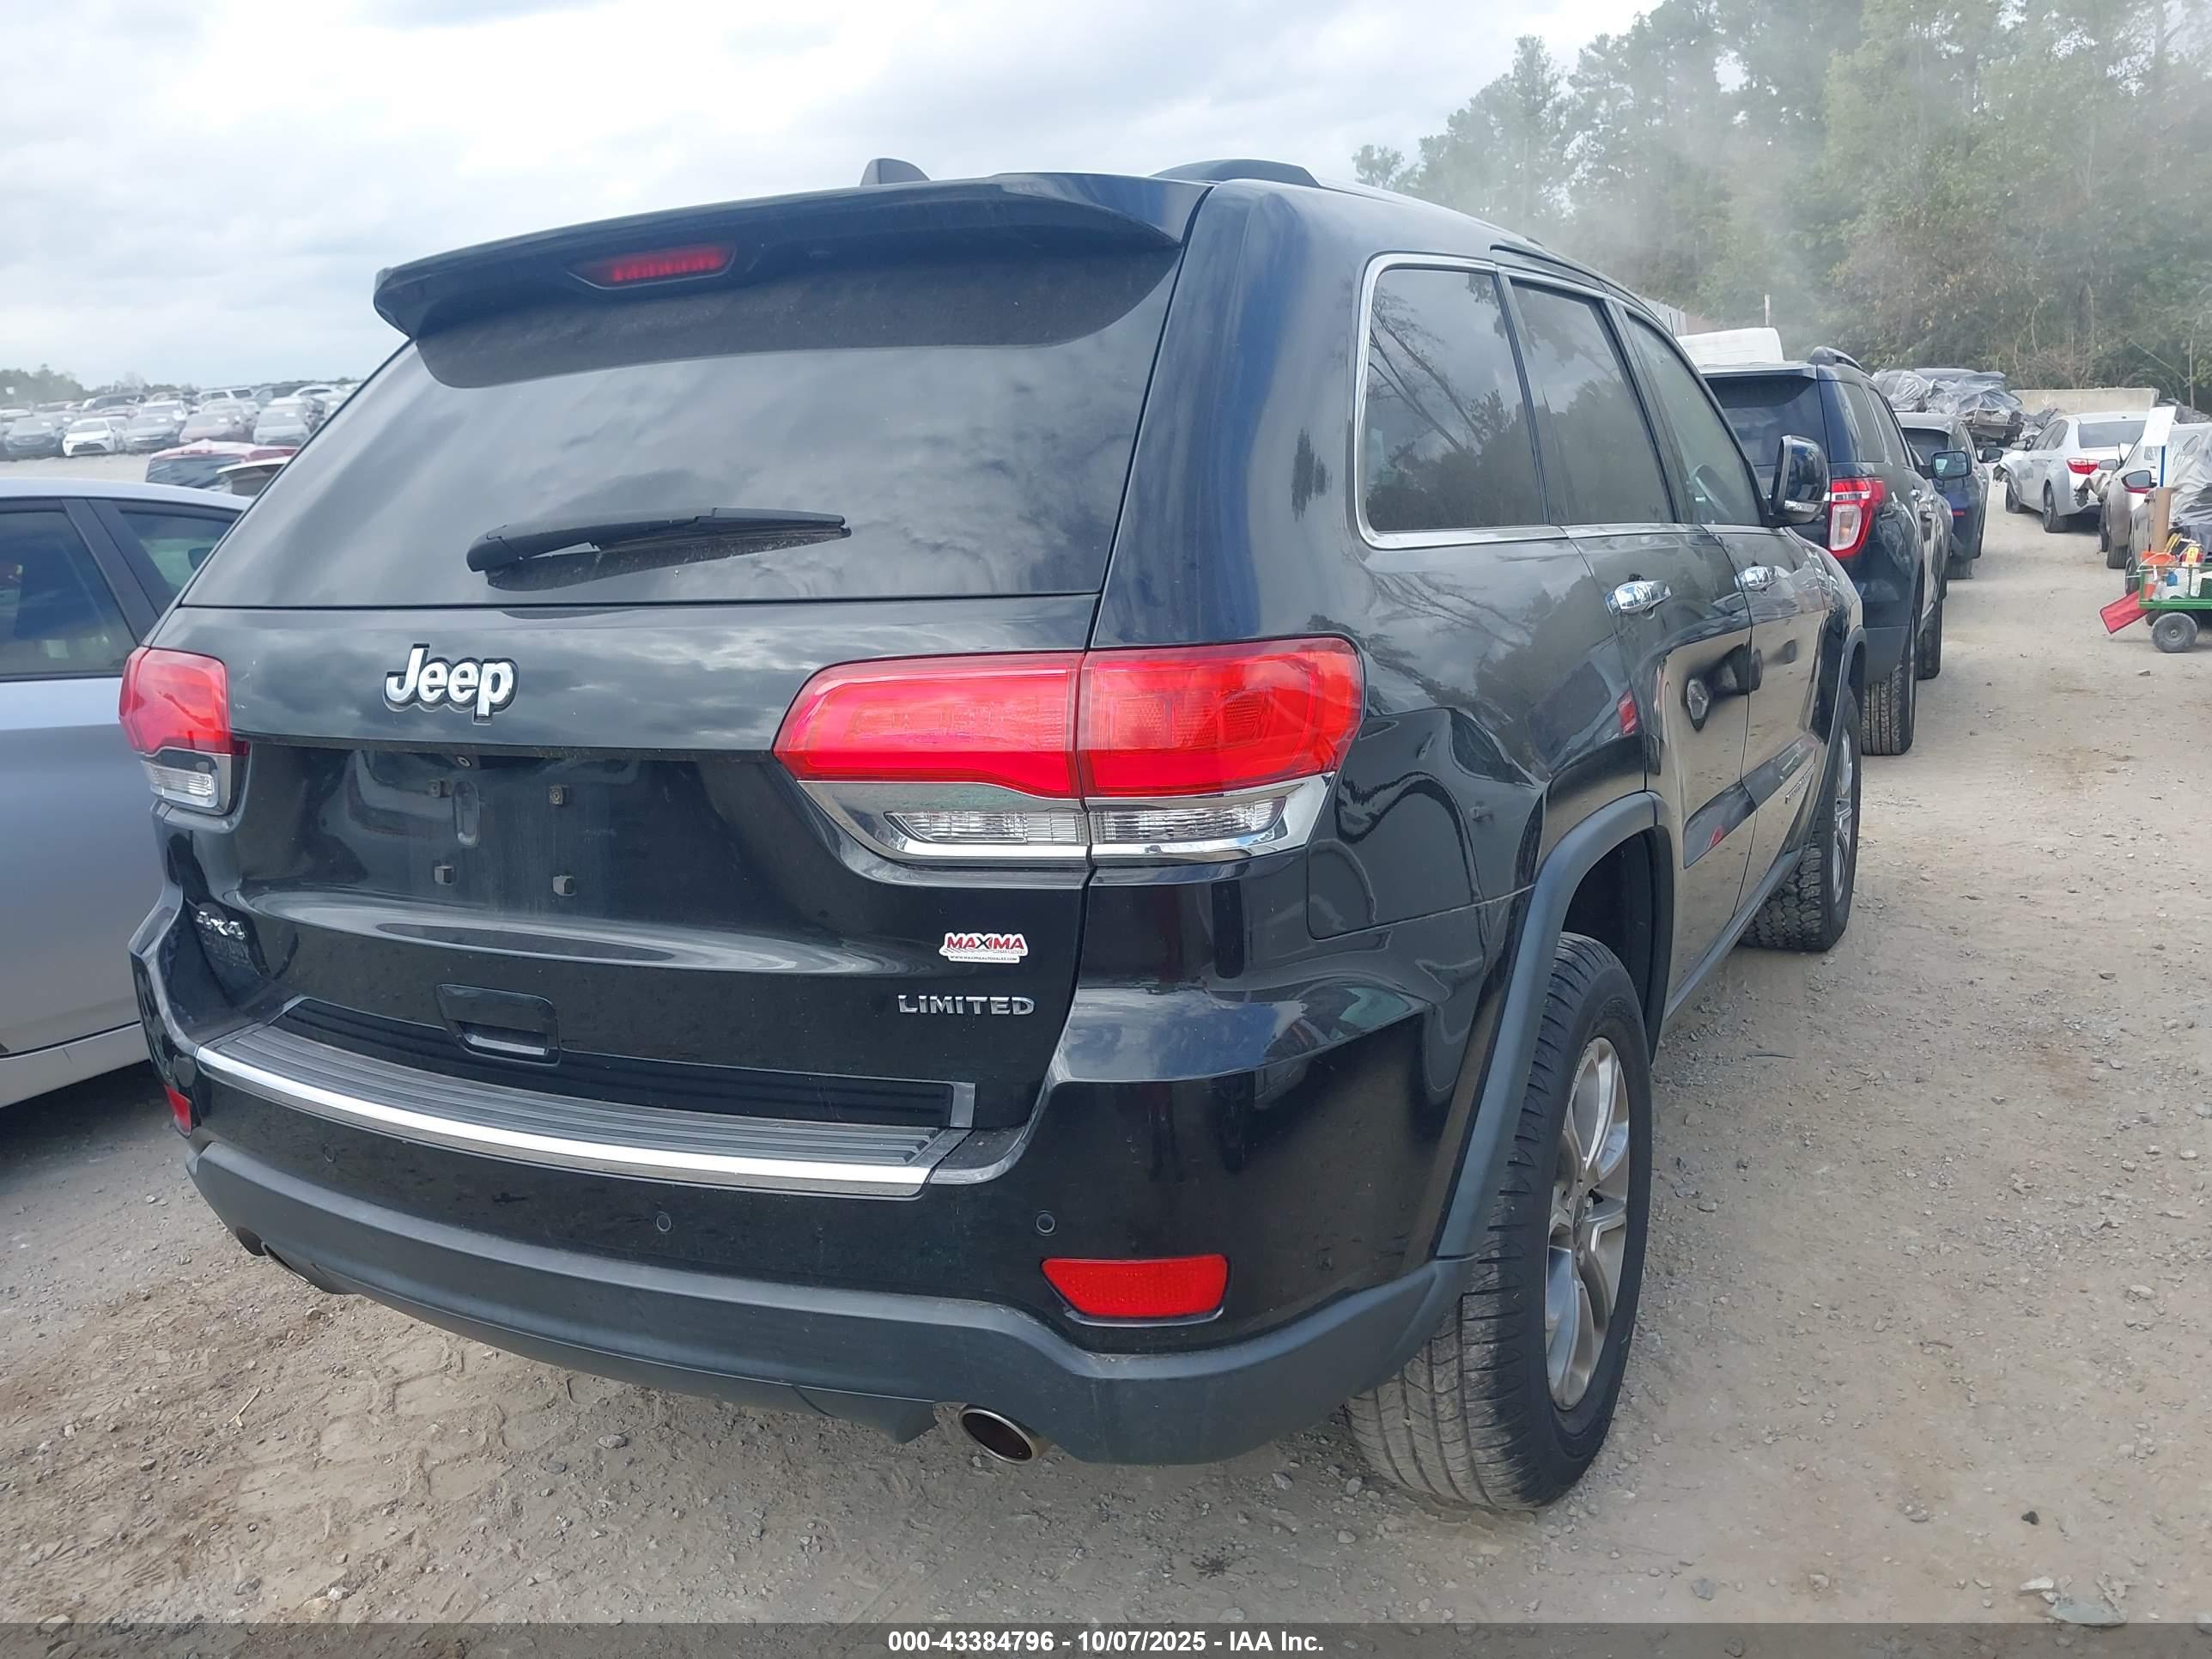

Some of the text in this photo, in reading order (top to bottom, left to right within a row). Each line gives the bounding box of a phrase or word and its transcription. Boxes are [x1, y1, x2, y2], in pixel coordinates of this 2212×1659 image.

[384, 643, 518, 724] Jeep
[946, 936, 1024, 949] MAXIMA
[898, 994, 1035, 1015] LIMITED
